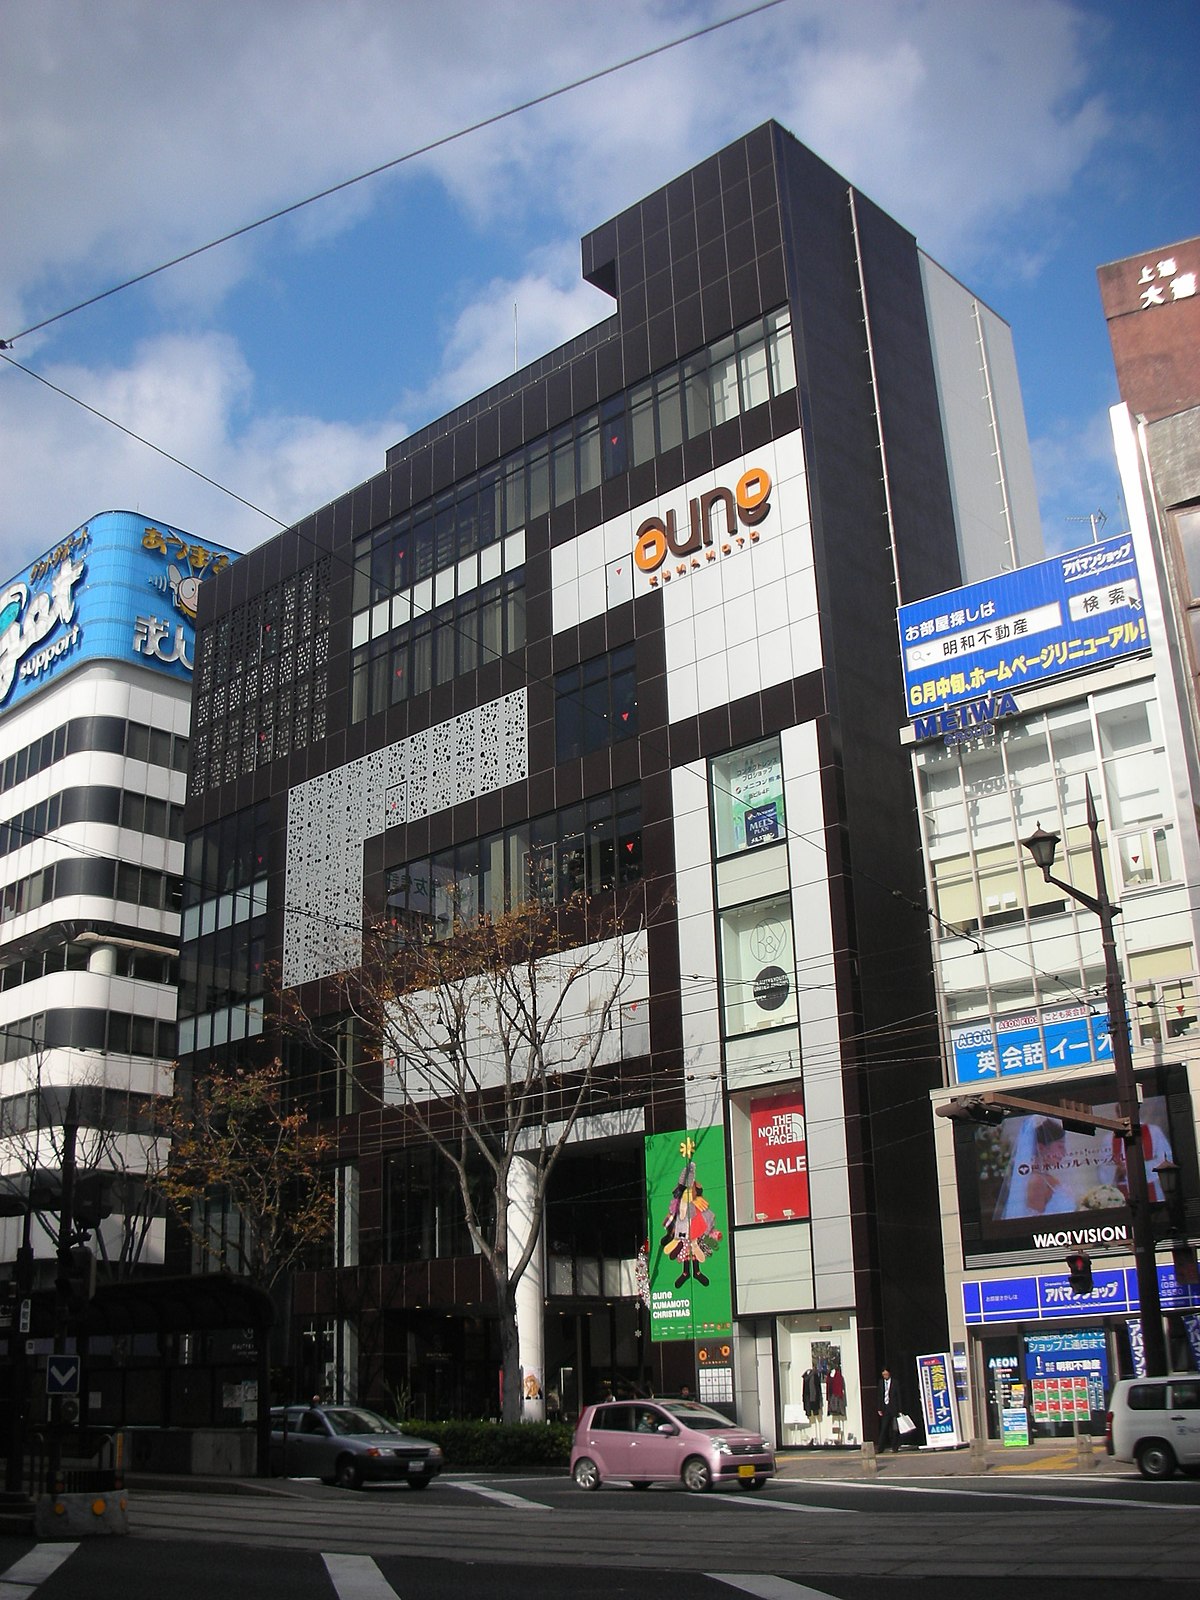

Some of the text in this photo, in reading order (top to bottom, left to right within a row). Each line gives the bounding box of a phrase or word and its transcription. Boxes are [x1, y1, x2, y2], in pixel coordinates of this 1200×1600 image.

[635, 468, 772, 573] aune
[649, 531, 760, 588] KUMAMOTO
[1062, 543, 1131, 577] アパマンショップ
[1083, 587, 1126, 613] 検索
[905, 601, 996, 642] お部屋探しは
[942, 618, 1029, 657] 明和不動産
[20, 624, 80, 680] support
[914, 693, 1020, 741] MEIWA
[943, 722, 993, 745] GROUP
[998, 1018, 1021, 1029] AEON
[957, 1029, 992, 1048] AEON
[772, 1113, 792, 1126] THE
[758, 1123, 792, 1138] NORTH
[768, 1133, 793, 1146] FACE
[765, 1155, 807, 1176] SALE
[652, 1291, 673, 1300] aune
[652, 1299, 690, 1309] KUMAMOTO
[652, 1309, 691, 1319] CHRISTMAS
[988, 1356, 1018, 1369] AEON
[930, 1424, 952, 1434] AEON
